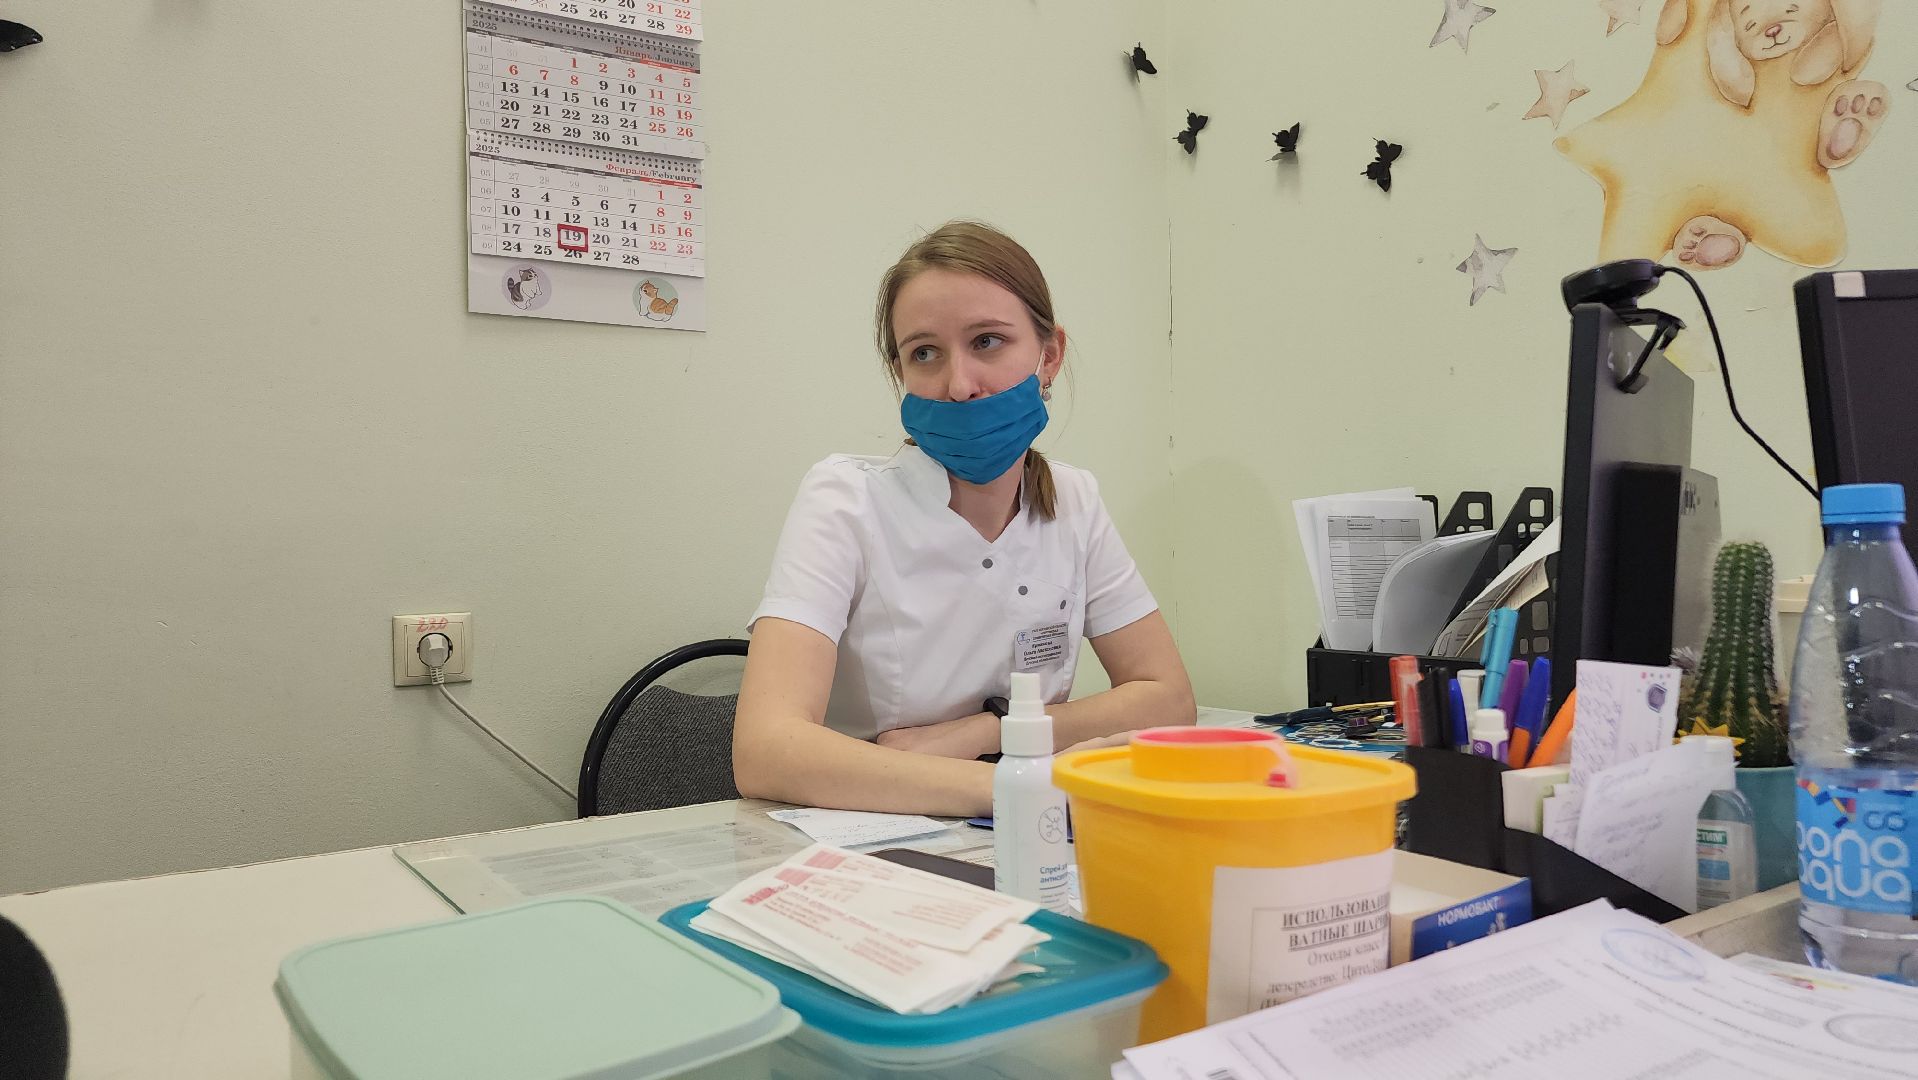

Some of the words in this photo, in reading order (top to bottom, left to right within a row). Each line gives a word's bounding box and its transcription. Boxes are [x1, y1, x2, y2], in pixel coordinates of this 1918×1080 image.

[473, 20, 497, 31] 2025
[560, 2, 578, 14] 25
[590, 8, 608, 20] 26
[619, 14, 636, 24] 27
[647, 19, 665, 30] 28
[676, 24, 692, 35] 29
[647, 3, 663, 14] 21
[675, 9, 691, 19] 22
[509, 65, 518, 75] 6
[540, 70, 548, 80] 7
[570, 75, 578, 85] 8
[599, 81, 608, 90] 9
[619, 83, 636, 95] 10
[649, 89, 664, 100] 11
[676, 93, 691, 104] 12
[571, 57, 578, 69] 1
[599, 63, 607, 73] 2
[628, 68, 636, 78] 3
[655, 74, 663, 83] 4
[683, 78, 691, 87] 5
[501, 82, 519, 93] 13
[532, 86, 549, 98] 14
[562, 91, 579, 103] 15
[592, 96, 608, 107] 16
[620, 101, 636, 112] 17
[649, 106, 665, 117] 18
[677, 110, 692, 120] 19
[501, 100, 519, 111] 20
[533, 104, 550, 116] 21
[562, 109, 580, 120] 22
[592, 114, 609, 125] 23
[620, 118, 637, 129] 24
[649, 122, 666, 133] 25
[677, 127, 693, 137] 26
[501, 117, 519, 129] 27
[533, 122, 550, 133] 28
[562, 127, 580, 138] 29
[593, 131, 610, 142] 30
[622, 135, 639, 146] 31
[476, 144, 500, 154] 2025
[512, 188, 520, 198] 3
[541, 192, 550, 202] 4
[572, 196, 580, 206] 5
[601, 200, 608, 210] 6
[629, 204, 636, 213] 7
[657, 207, 664, 217] 8
[684, 211, 691, 220] 9
[658, 190, 664, 200] 1
[684, 194, 691, 204] 2
[502, 205, 520, 216] 10
[535, 209, 551, 220] 11
[564, 213, 580, 223] 12
[594, 217, 609, 228] 13
[621, 220, 637, 231] 14
[650, 224, 665, 234] 15
[677, 227, 692, 237] 16
[503, 223, 520, 234] 17
[534, 227, 551, 238] 18
[565, 230, 581, 241] 19
[593, 234, 610, 245] 20
[622, 237, 638, 248] 21
[650, 240, 666, 251] 22
[677, 244, 693, 254] 23
[503, 241, 521, 252] 24
[534, 244, 552, 255] 25
[564, 247, 582, 258] 26
[594, 251, 610, 261] 27
[622, 254, 639, 265] 28
[1288, 924, 1349, 948] ВАТНЫЕ
